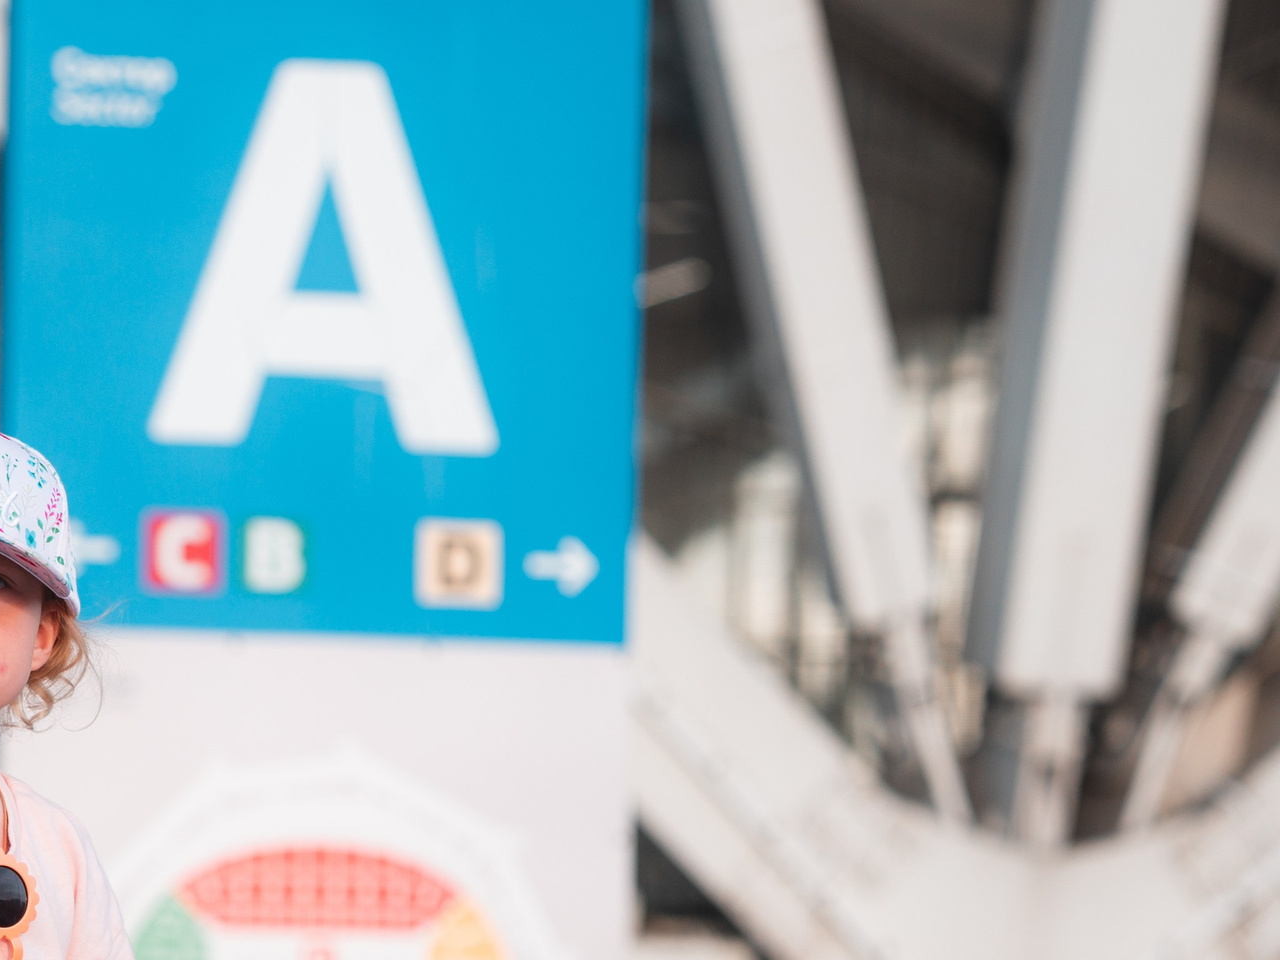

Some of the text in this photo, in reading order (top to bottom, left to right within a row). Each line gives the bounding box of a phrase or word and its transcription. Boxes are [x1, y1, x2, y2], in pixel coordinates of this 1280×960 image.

[147, 58, 499, 456] A
[154, 513, 488, 594] C B D
